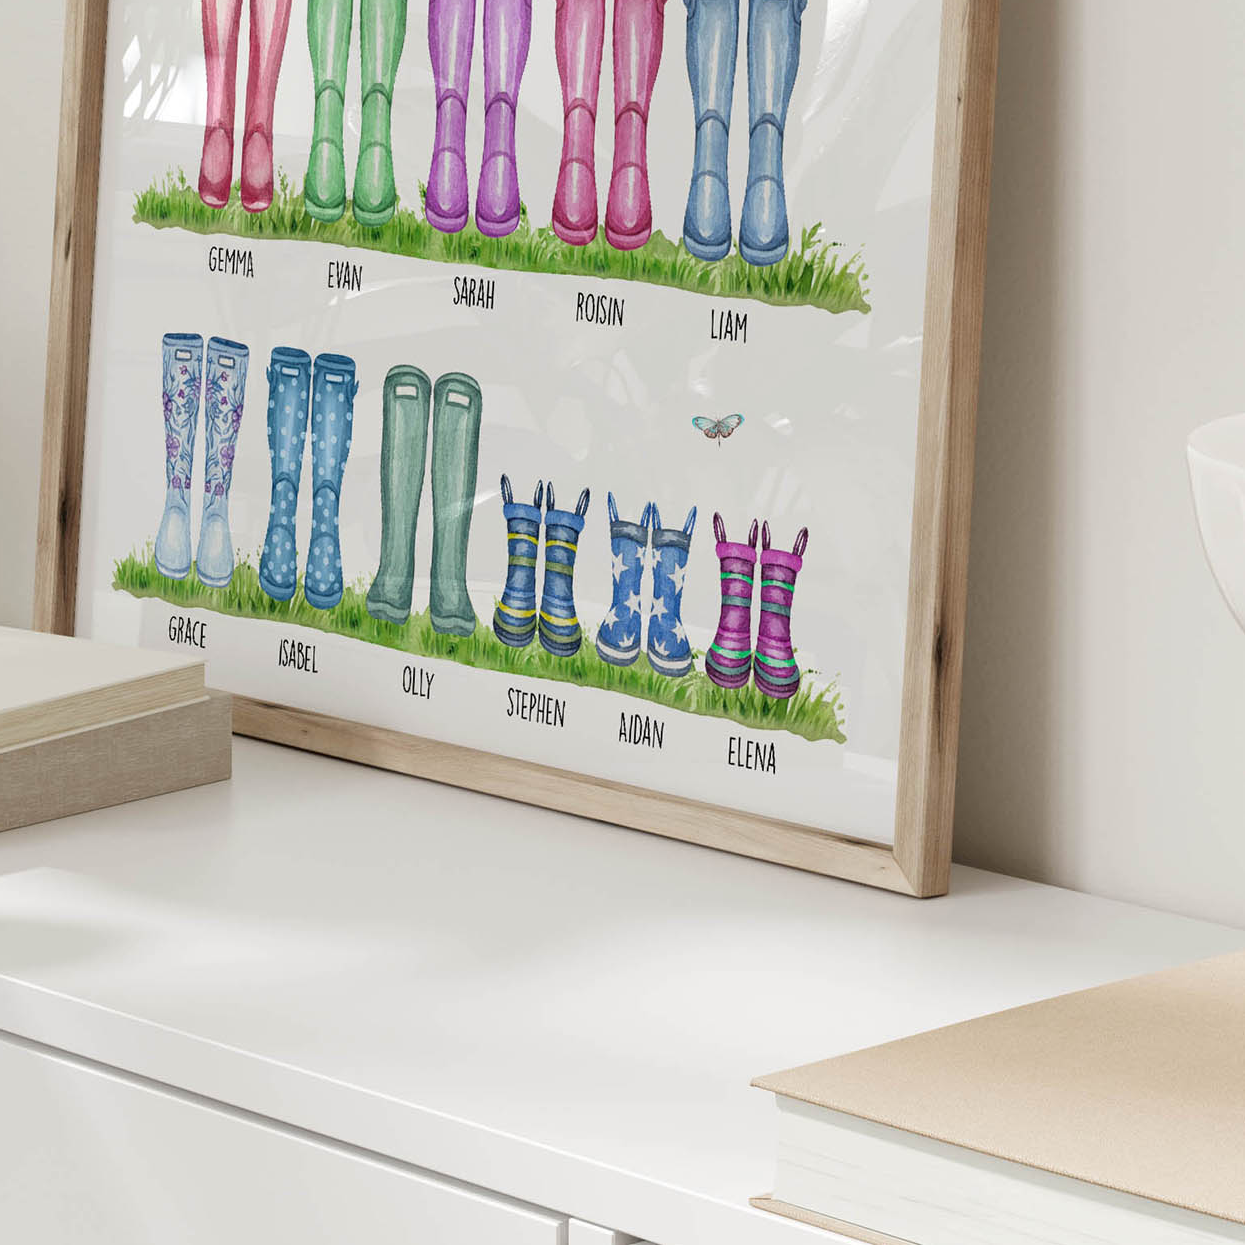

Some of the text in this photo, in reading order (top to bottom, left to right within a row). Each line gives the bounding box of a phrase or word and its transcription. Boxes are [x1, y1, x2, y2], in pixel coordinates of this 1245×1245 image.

[209, 246, 254, 278] GEMMA
[328, 261, 362, 291] EVAN
[453, 277, 495, 309] SARAH
[576, 292, 624, 326] ROISIN
[711, 309, 747, 343] LIAM
[169, 616, 206, 649] GRACE
[279, 639, 318, 674] ISABEL
[403, 666, 434, 699] OLLY
[507, 688, 566, 727] STEPHEN
[619, 712, 664, 749] AIDAN
[728, 737, 776, 774] ELENA
